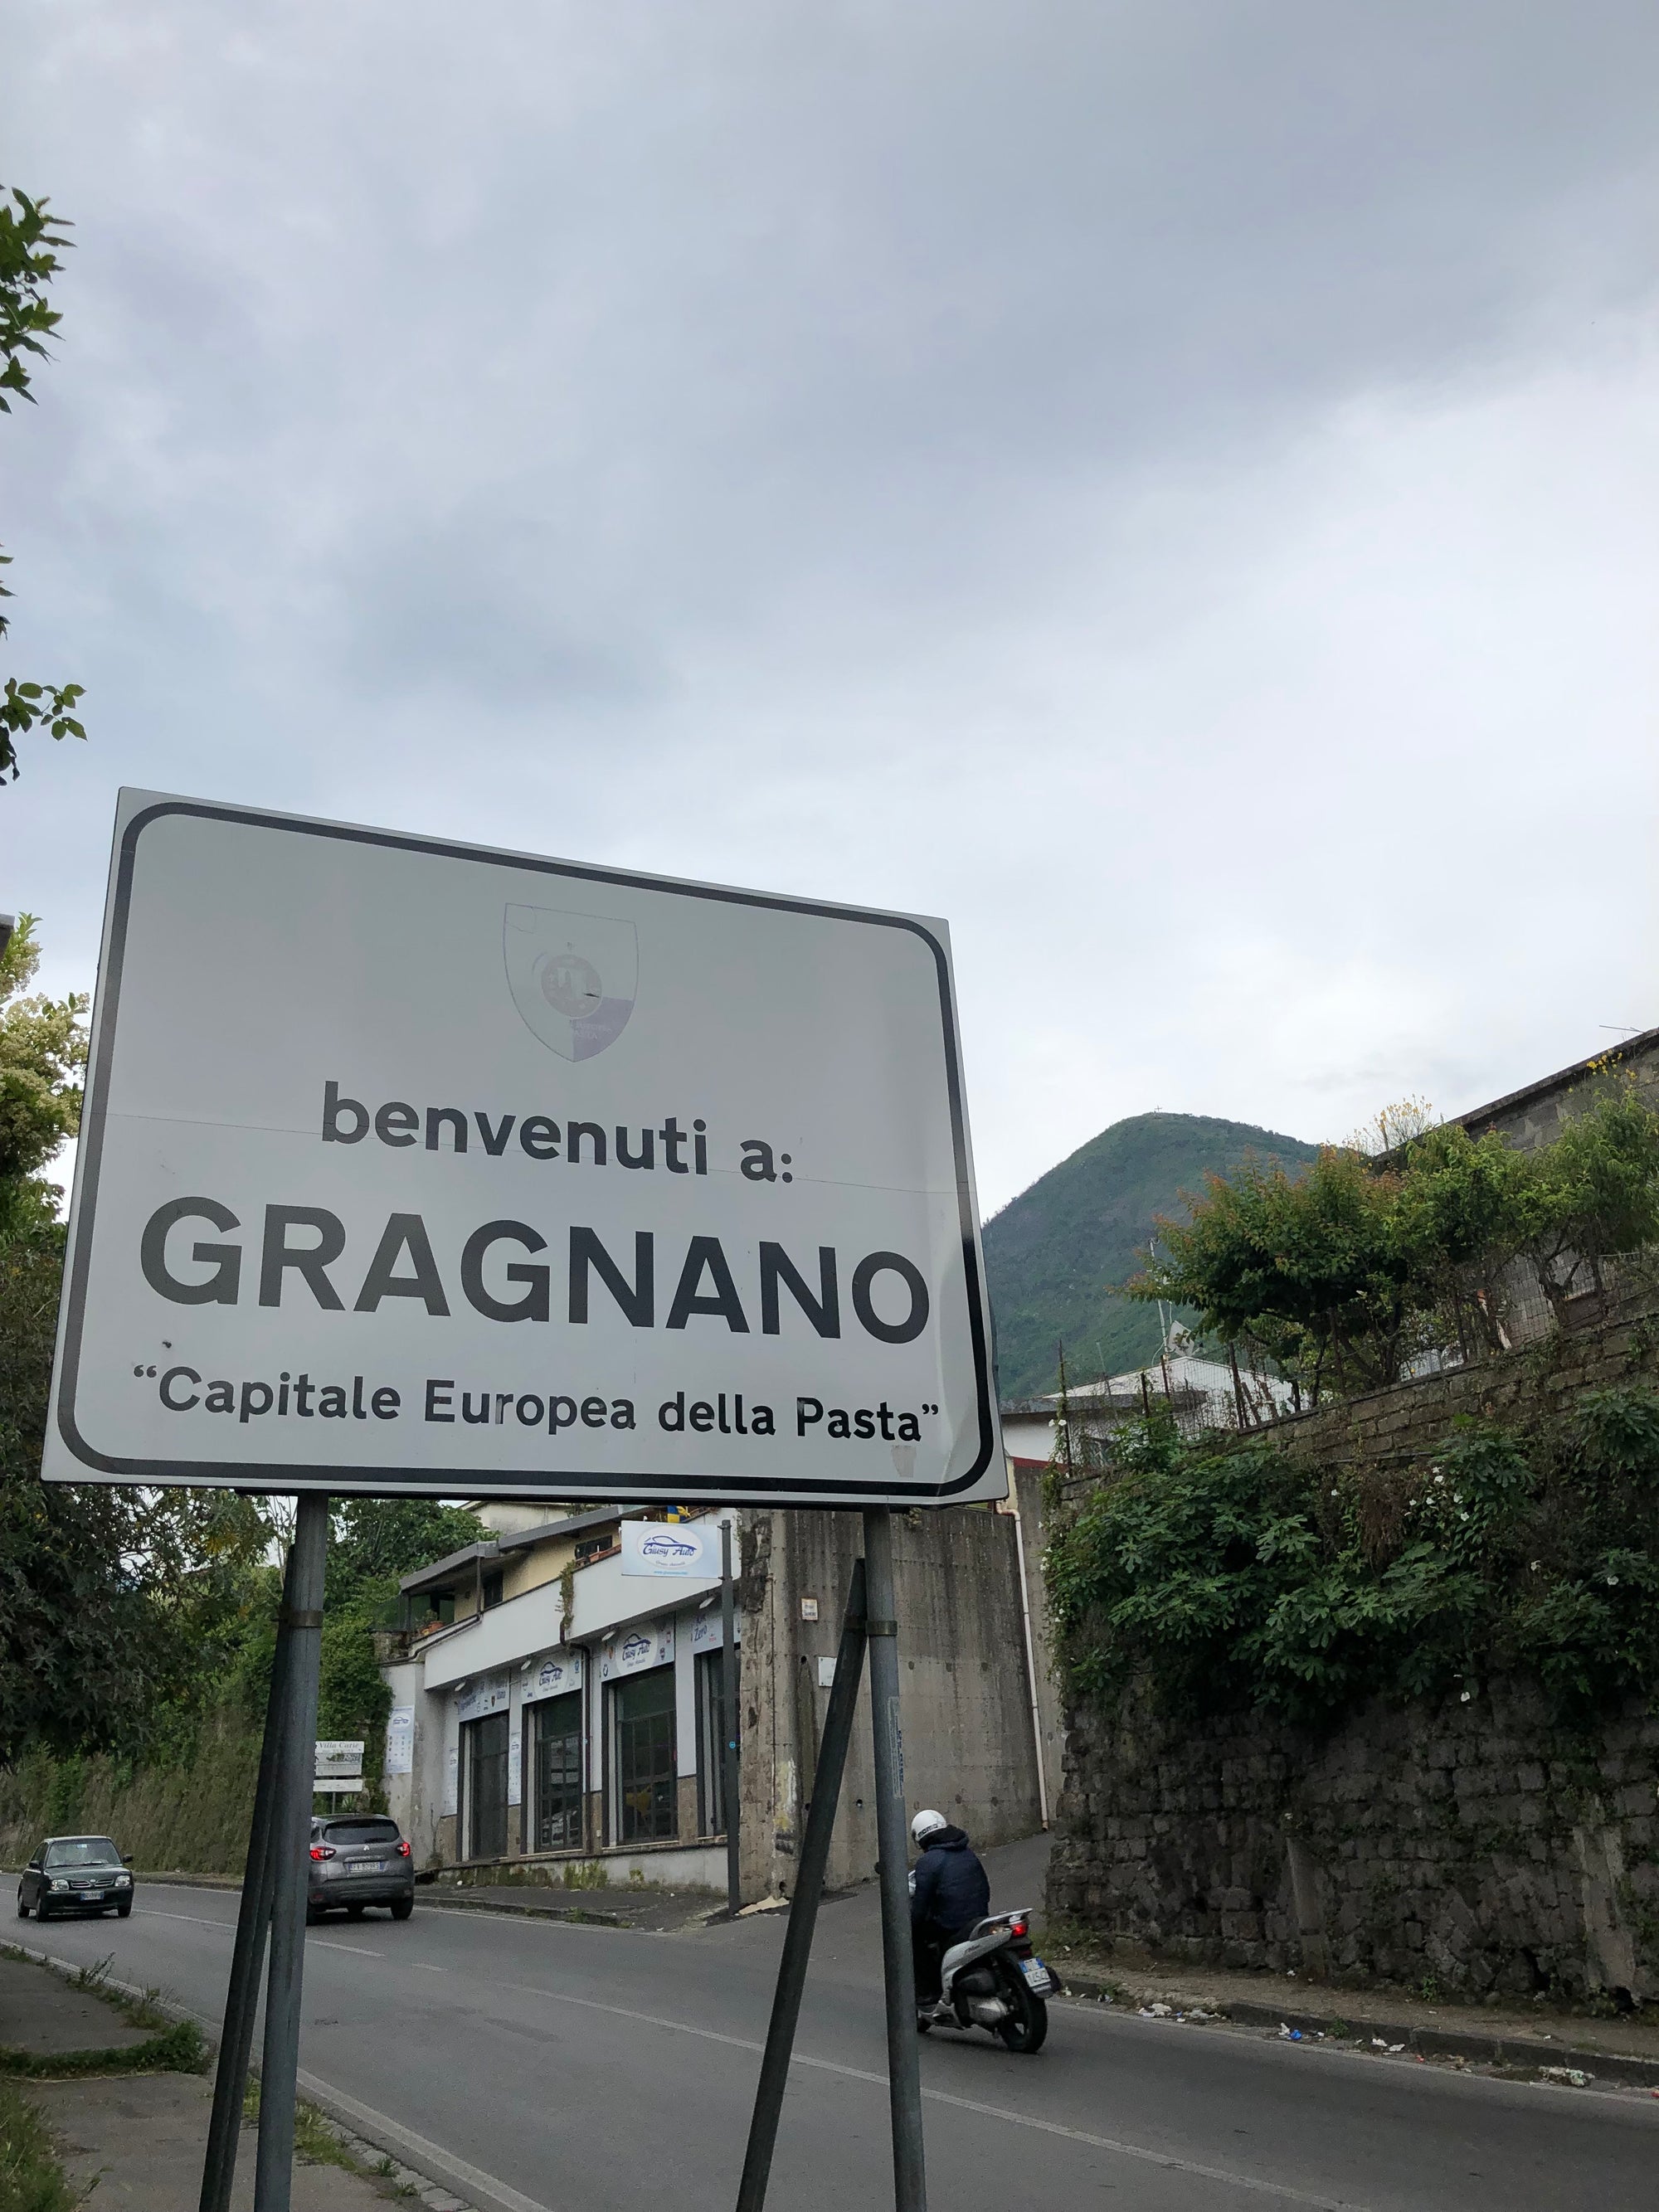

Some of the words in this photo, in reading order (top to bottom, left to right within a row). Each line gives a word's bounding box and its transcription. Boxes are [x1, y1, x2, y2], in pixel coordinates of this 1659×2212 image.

[321, 1080, 708, 1176] benvenuti
[739, 1140, 793, 1184] a:
[140, 1196, 930, 1344] GRAGNANO
[133, 1364, 401, 1424] “Capitale
[424, 1378, 637, 1436] Europea
[658, 1391, 776, 1437] della
[796, 1397, 939, 1442] Pasta”
[642, 1544, 669, 1557] Giusy
[672, 1545, 695, 1557] Auto
